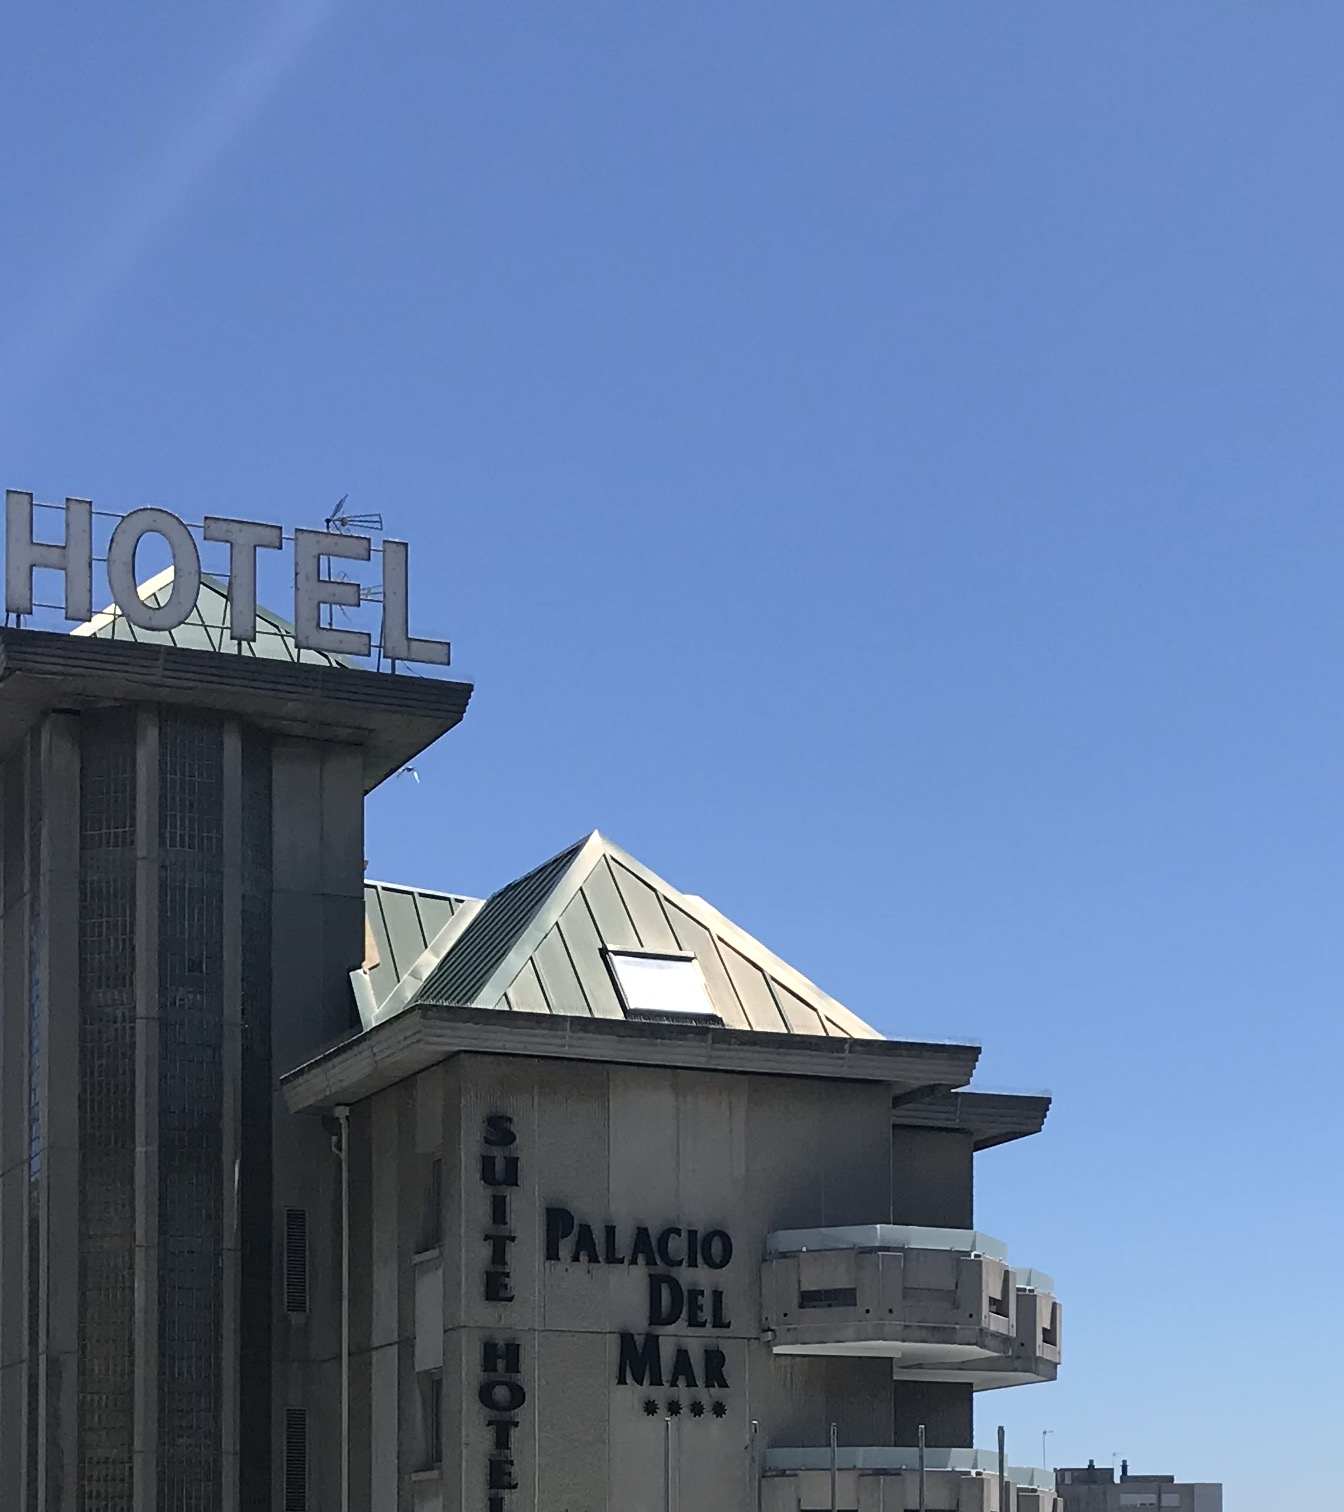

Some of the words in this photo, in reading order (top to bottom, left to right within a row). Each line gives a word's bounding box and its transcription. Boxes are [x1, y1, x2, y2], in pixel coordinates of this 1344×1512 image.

[6, 488, 451, 667] HOTEL
[480, 1114, 520, 1303] SUITE
[545, 1206, 734, 1270] PALACIO
[648, 1273, 731, 1329] DEL
[616, 1332, 730, 1388] MAR
